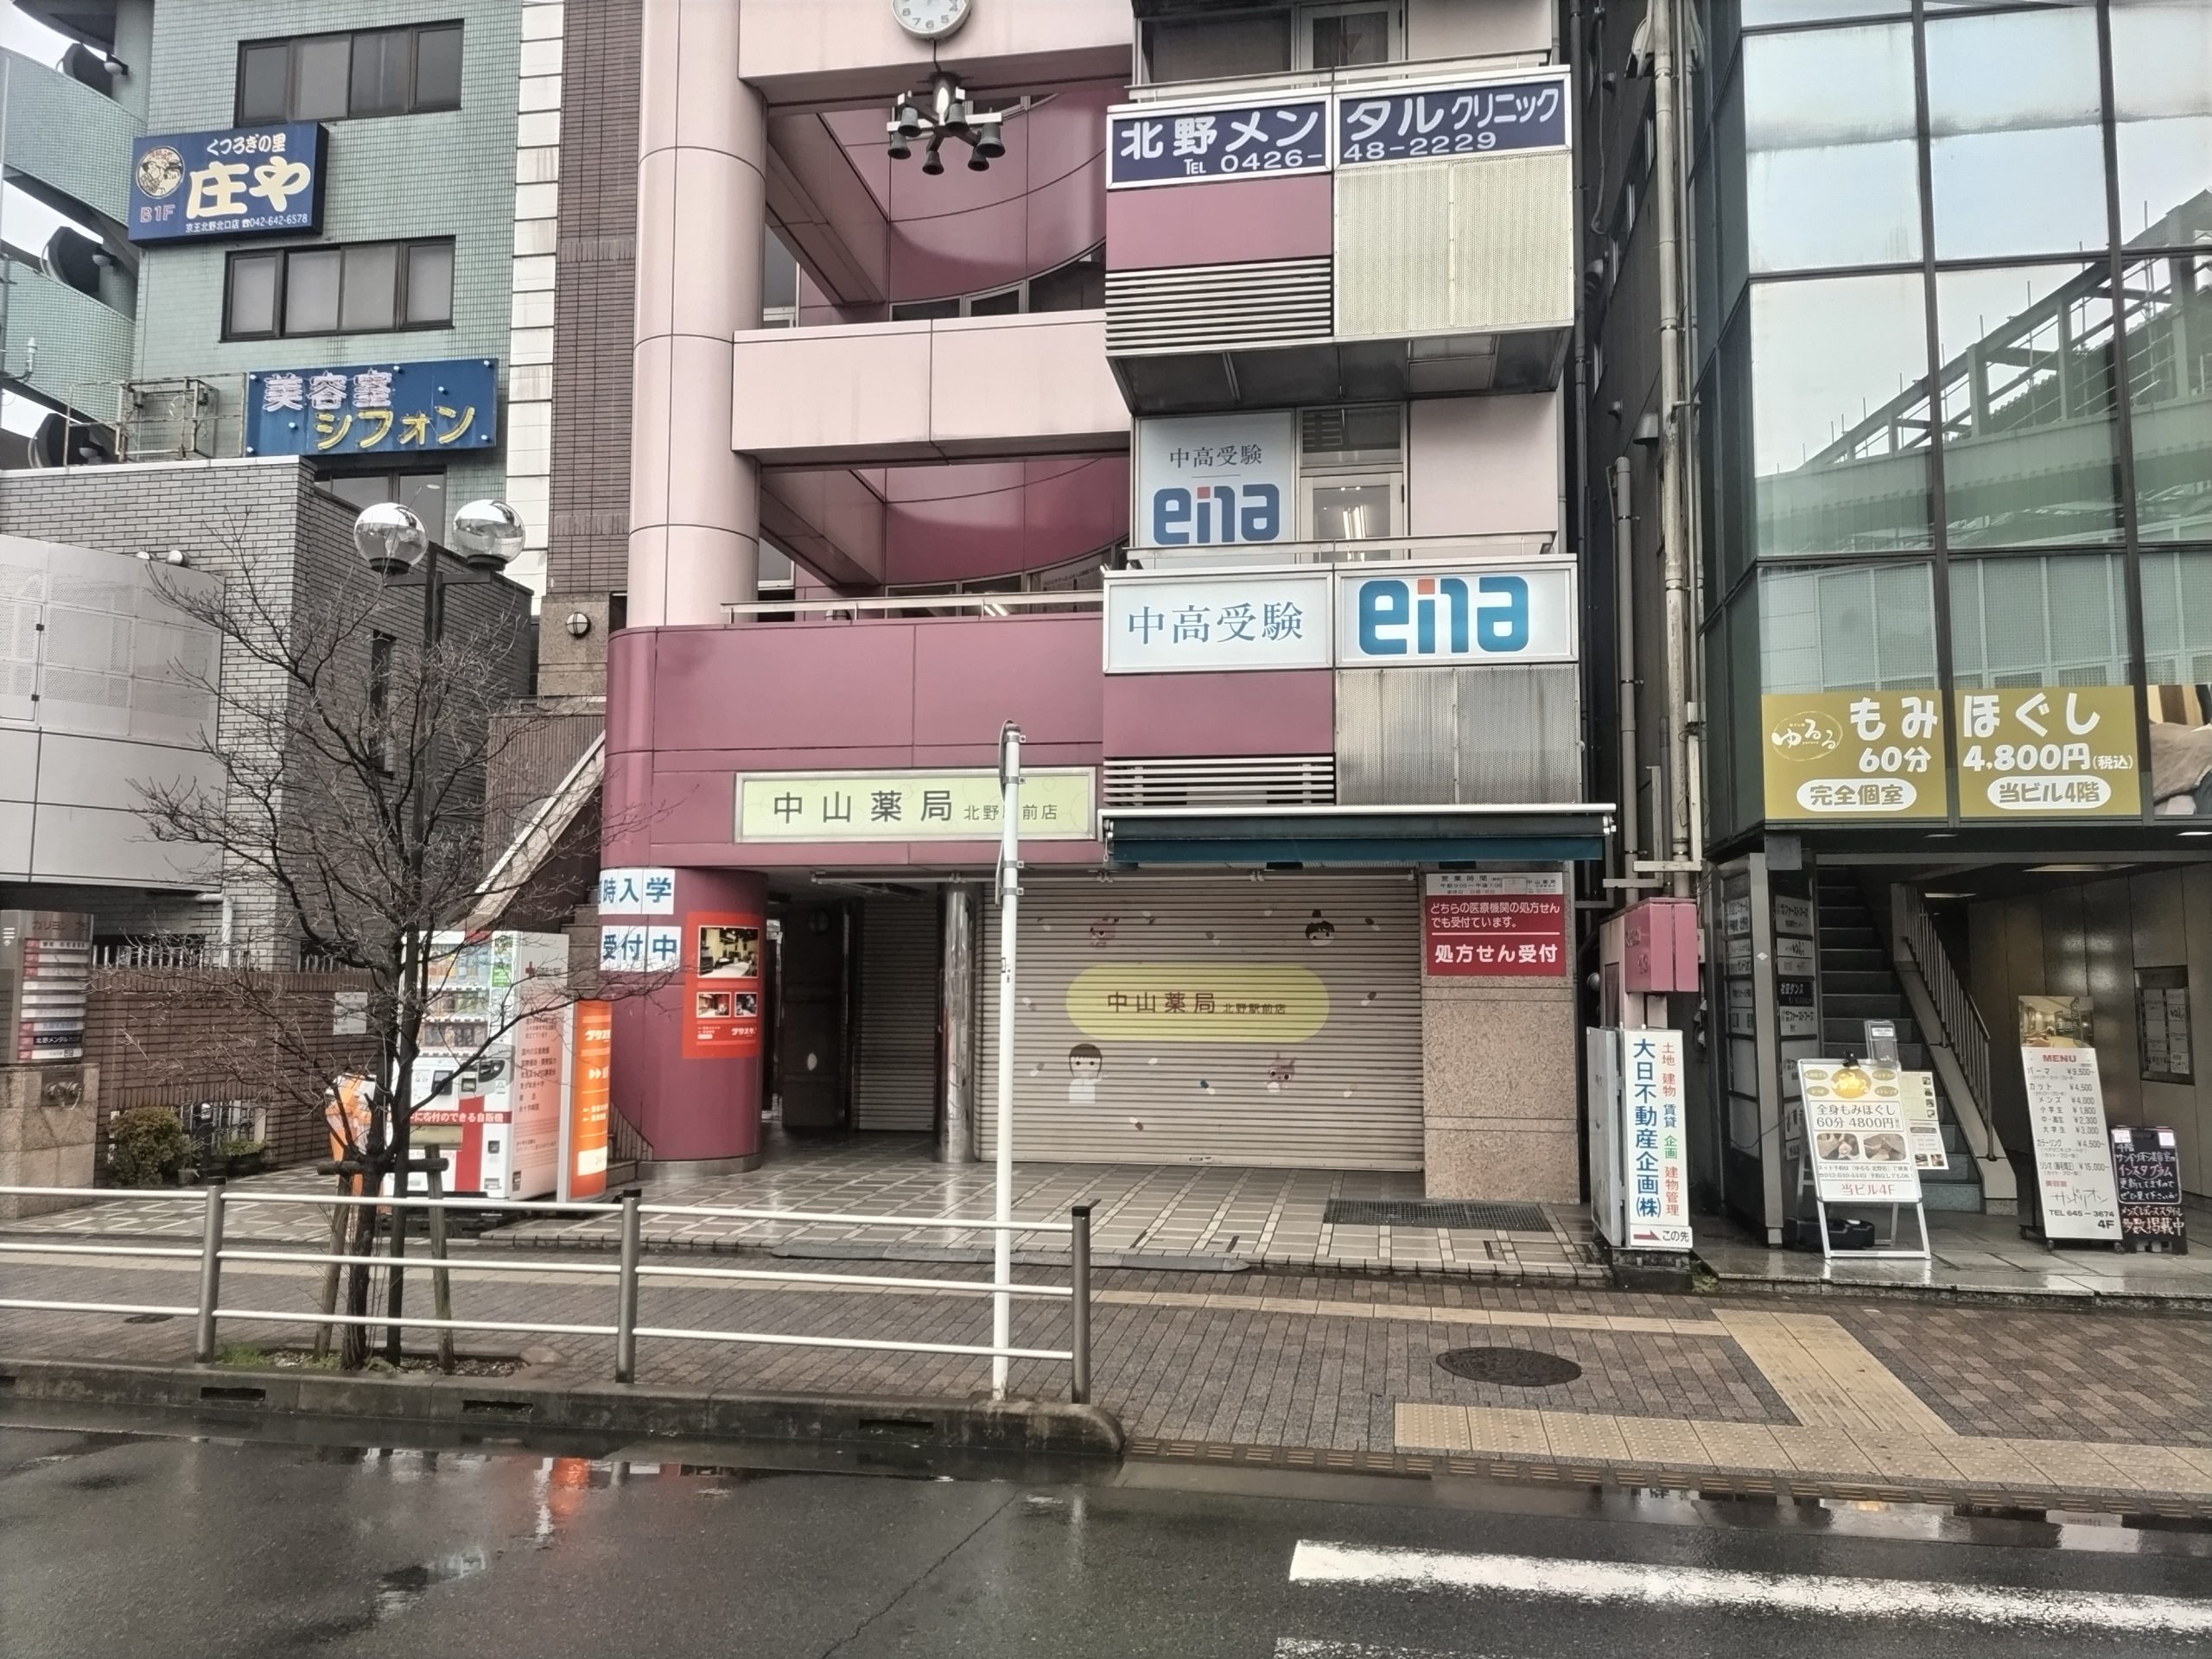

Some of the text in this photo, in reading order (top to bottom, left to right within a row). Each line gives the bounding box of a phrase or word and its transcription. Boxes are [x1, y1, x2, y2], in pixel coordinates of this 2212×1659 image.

[207, 133, 286, 156] くつろぎの里
[187, 156, 311, 219] 庄や
[140, 204, 175, 223] B1F
[185, 219, 239, 233] 京王北野北口店
[263, 369, 393, 412] 美容室
[315, 406, 475, 450] シフォン
[1169, 443, 1262, 469] 中高受験
[1153, 482, 1281, 545] ena
[1128, 575, 1529, 655] 中高受験 ena
[1859, 747, 1932, 773] 60分
[1809, 782, 1904, 807] 完全個室
[1999, 781, 2101, 804] 当ビル4階
[773, 790, 1058, 824] 中山薬局 北野前店
[598, 876, 672, 904] 時入学
[1430, 902, 1560, 914] どちらの医療機関の処方せん
[1431, 916, 1517, 929] でも受付ています。
[602, 933, 677, 961] 受付中
[1434, 944, 1559, 963] 処方せん受付
[1108, 992, 1216, 1014] 中山薬局
[1817, 1104, 1896, 1116] 全身もみほぐし
[1633, 1038, 1662, 1218] 大日不動産企画(株)
[1817, 1117, 1843, 1128] 60分
[1841, 1184, 1895, 1196] 当ビル4F
[2098, 1219, 2114, 1230] 4F
[1662, 1230, 1689, 1243] この先
